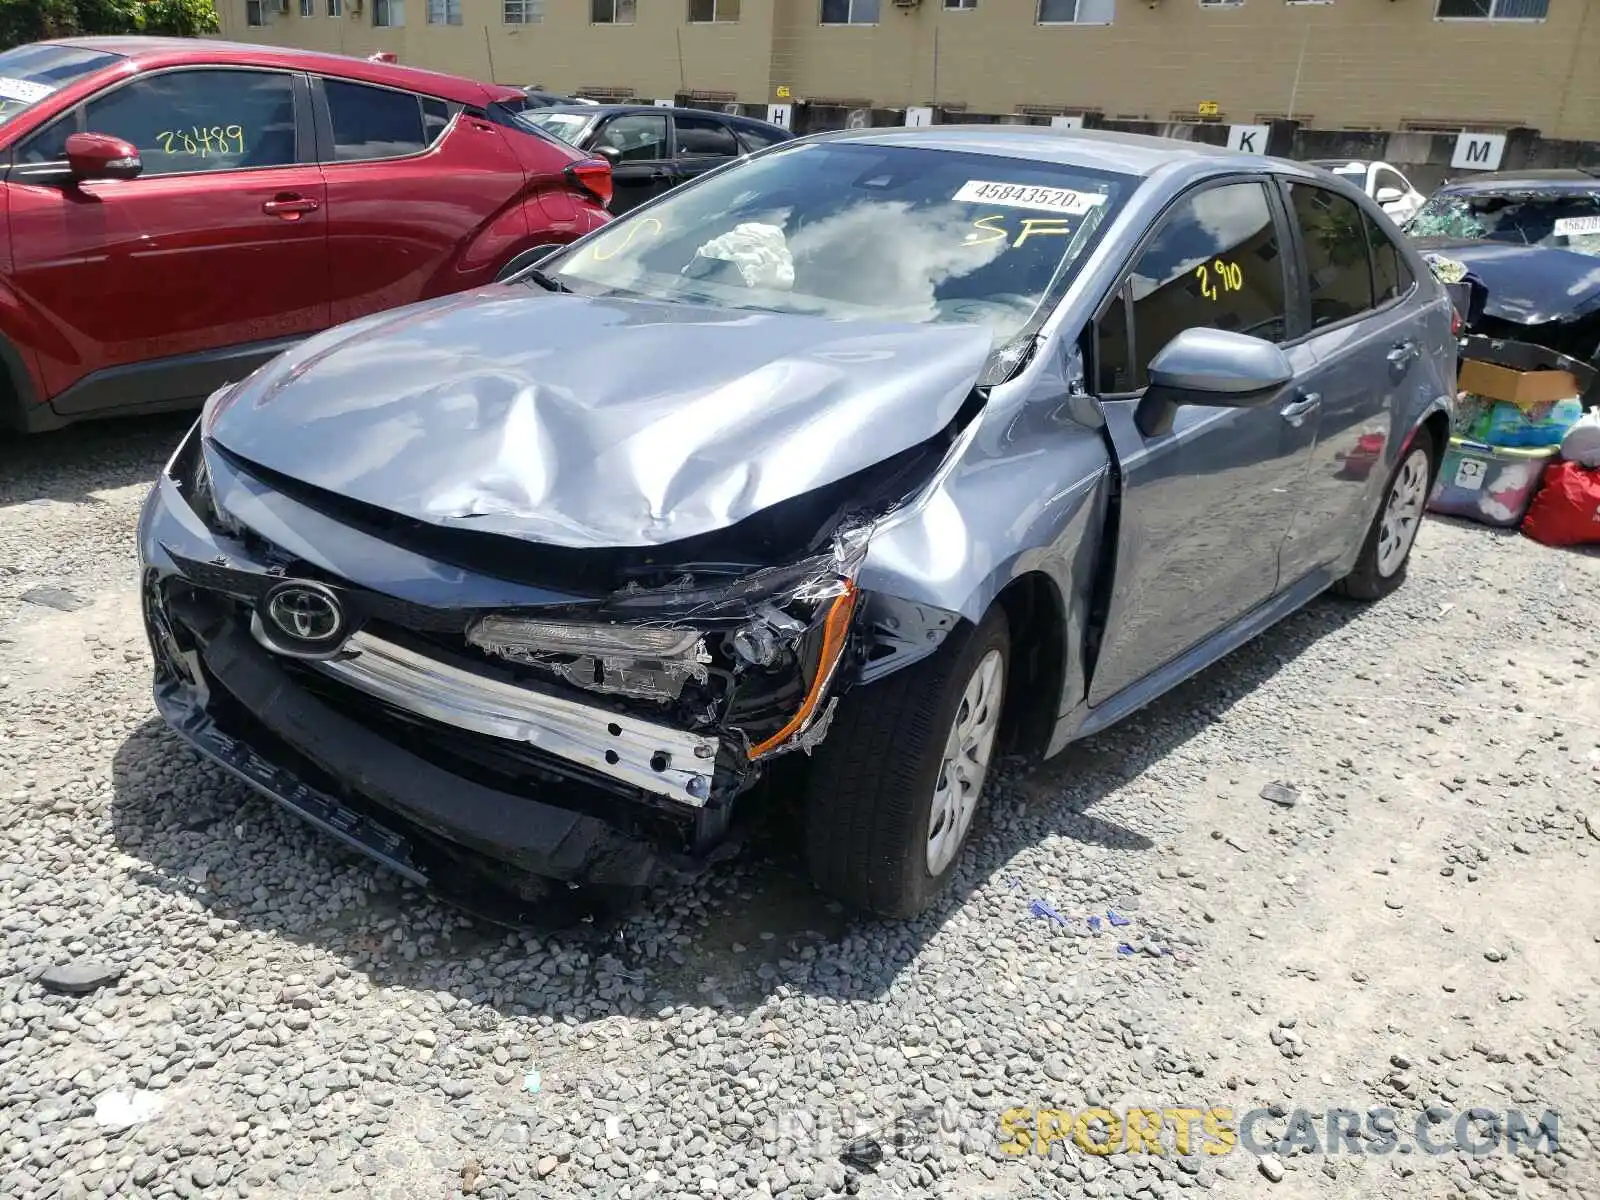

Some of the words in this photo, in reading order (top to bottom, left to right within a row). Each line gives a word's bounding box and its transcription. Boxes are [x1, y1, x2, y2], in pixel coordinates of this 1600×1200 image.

[774, 109, 783, 124] H
[1240, 131, 1257, 153] K
[1466, 140, 1491, 163] M
